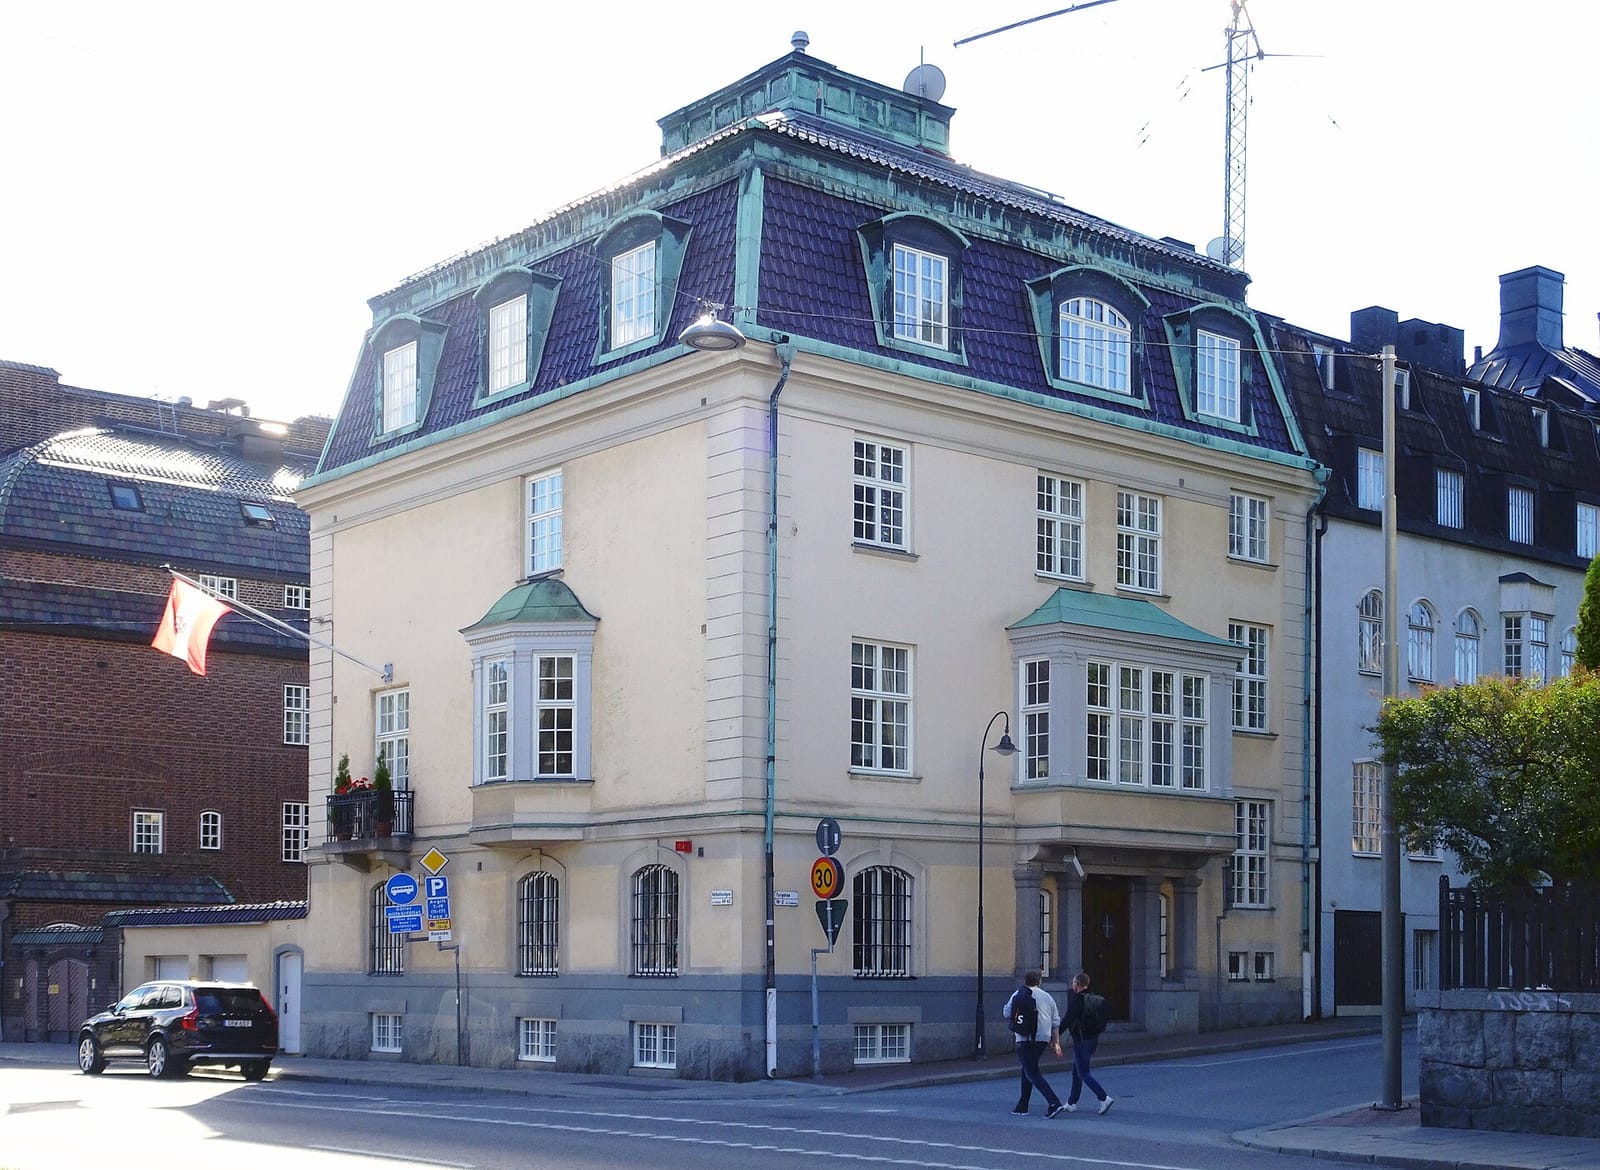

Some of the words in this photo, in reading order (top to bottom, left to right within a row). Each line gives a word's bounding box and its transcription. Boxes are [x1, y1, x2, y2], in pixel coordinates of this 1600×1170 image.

[814, 868, 833, 888] 30
[431, 879, 444, 897] P
[1016, 1015, 1024, 1024] S
